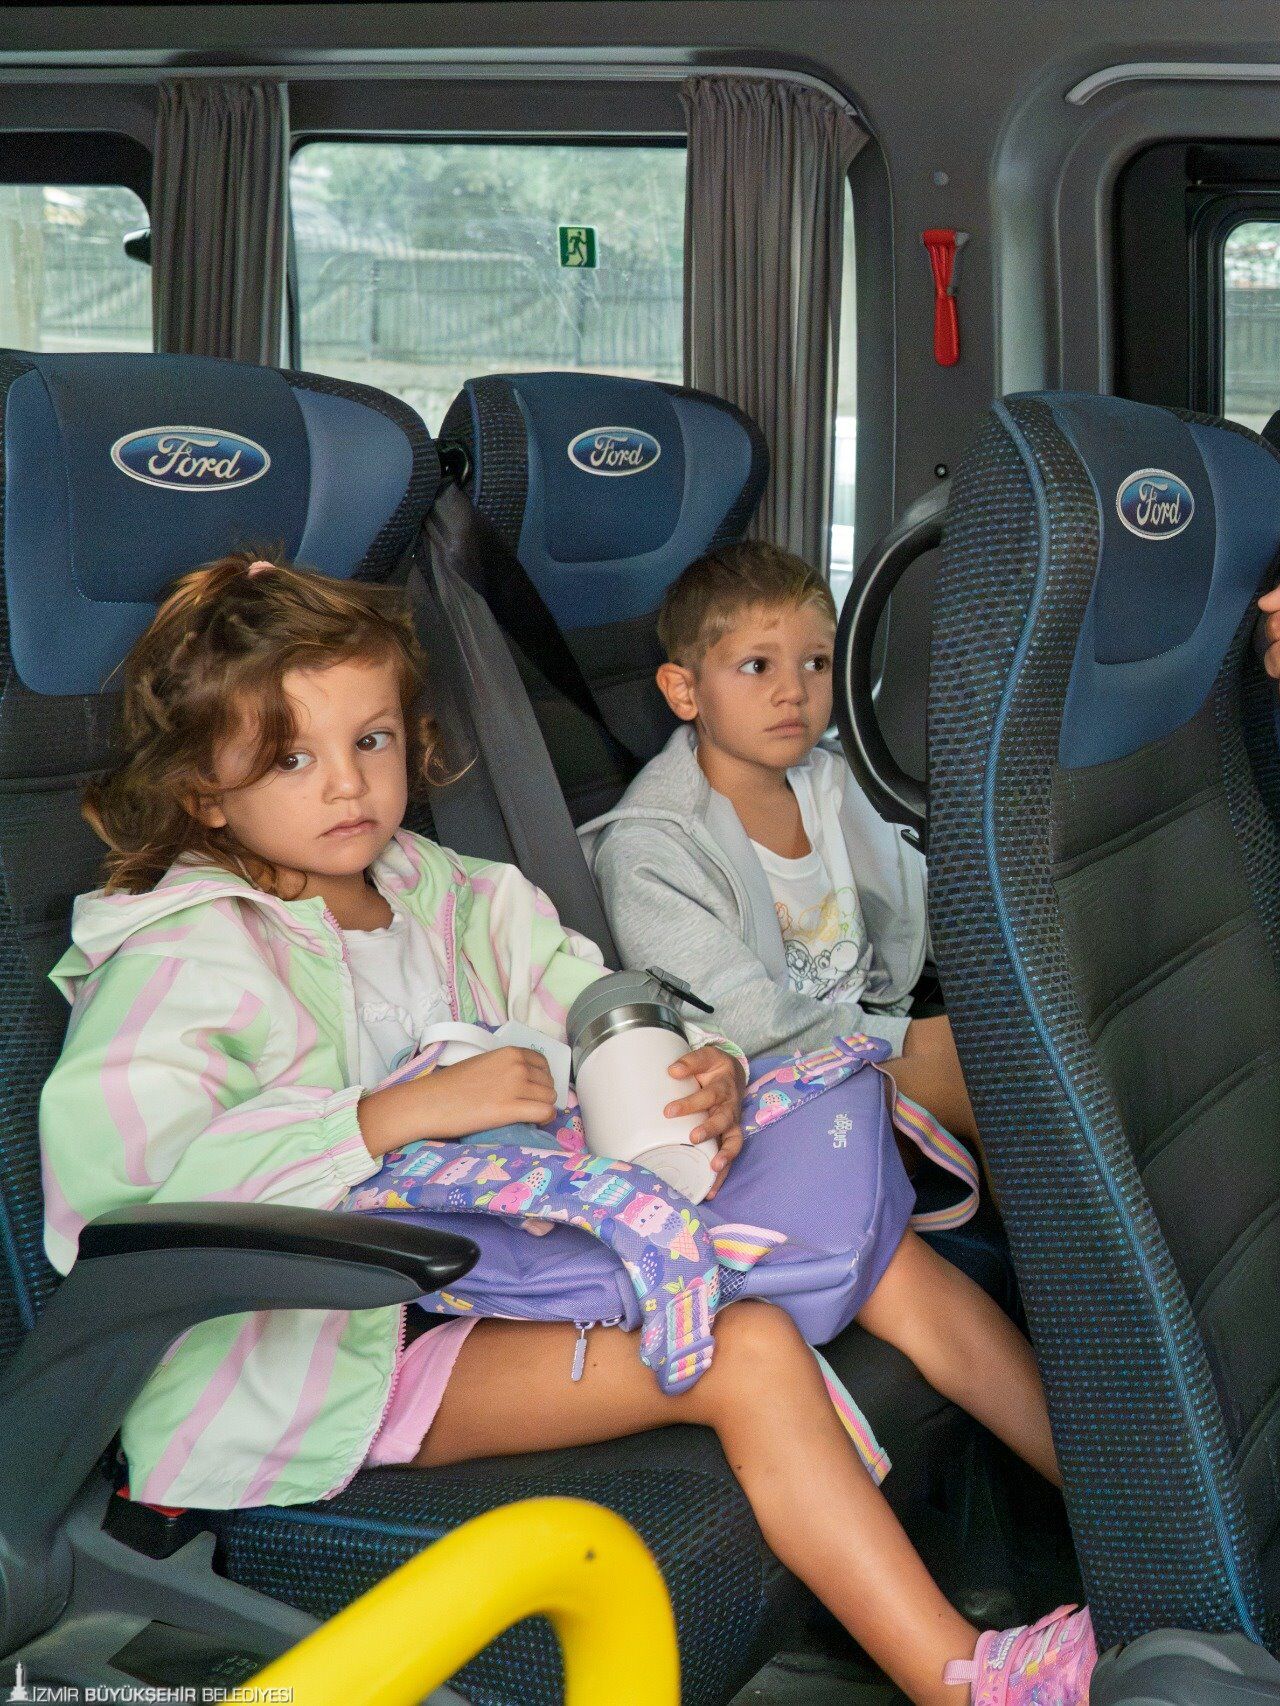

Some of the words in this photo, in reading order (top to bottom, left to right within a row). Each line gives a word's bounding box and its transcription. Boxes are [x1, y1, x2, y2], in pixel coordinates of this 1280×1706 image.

[148, 434, 242, 479] Ford
[590, 434, 644, 467] Ford
[1136, 480, 1181, 526] Ford
